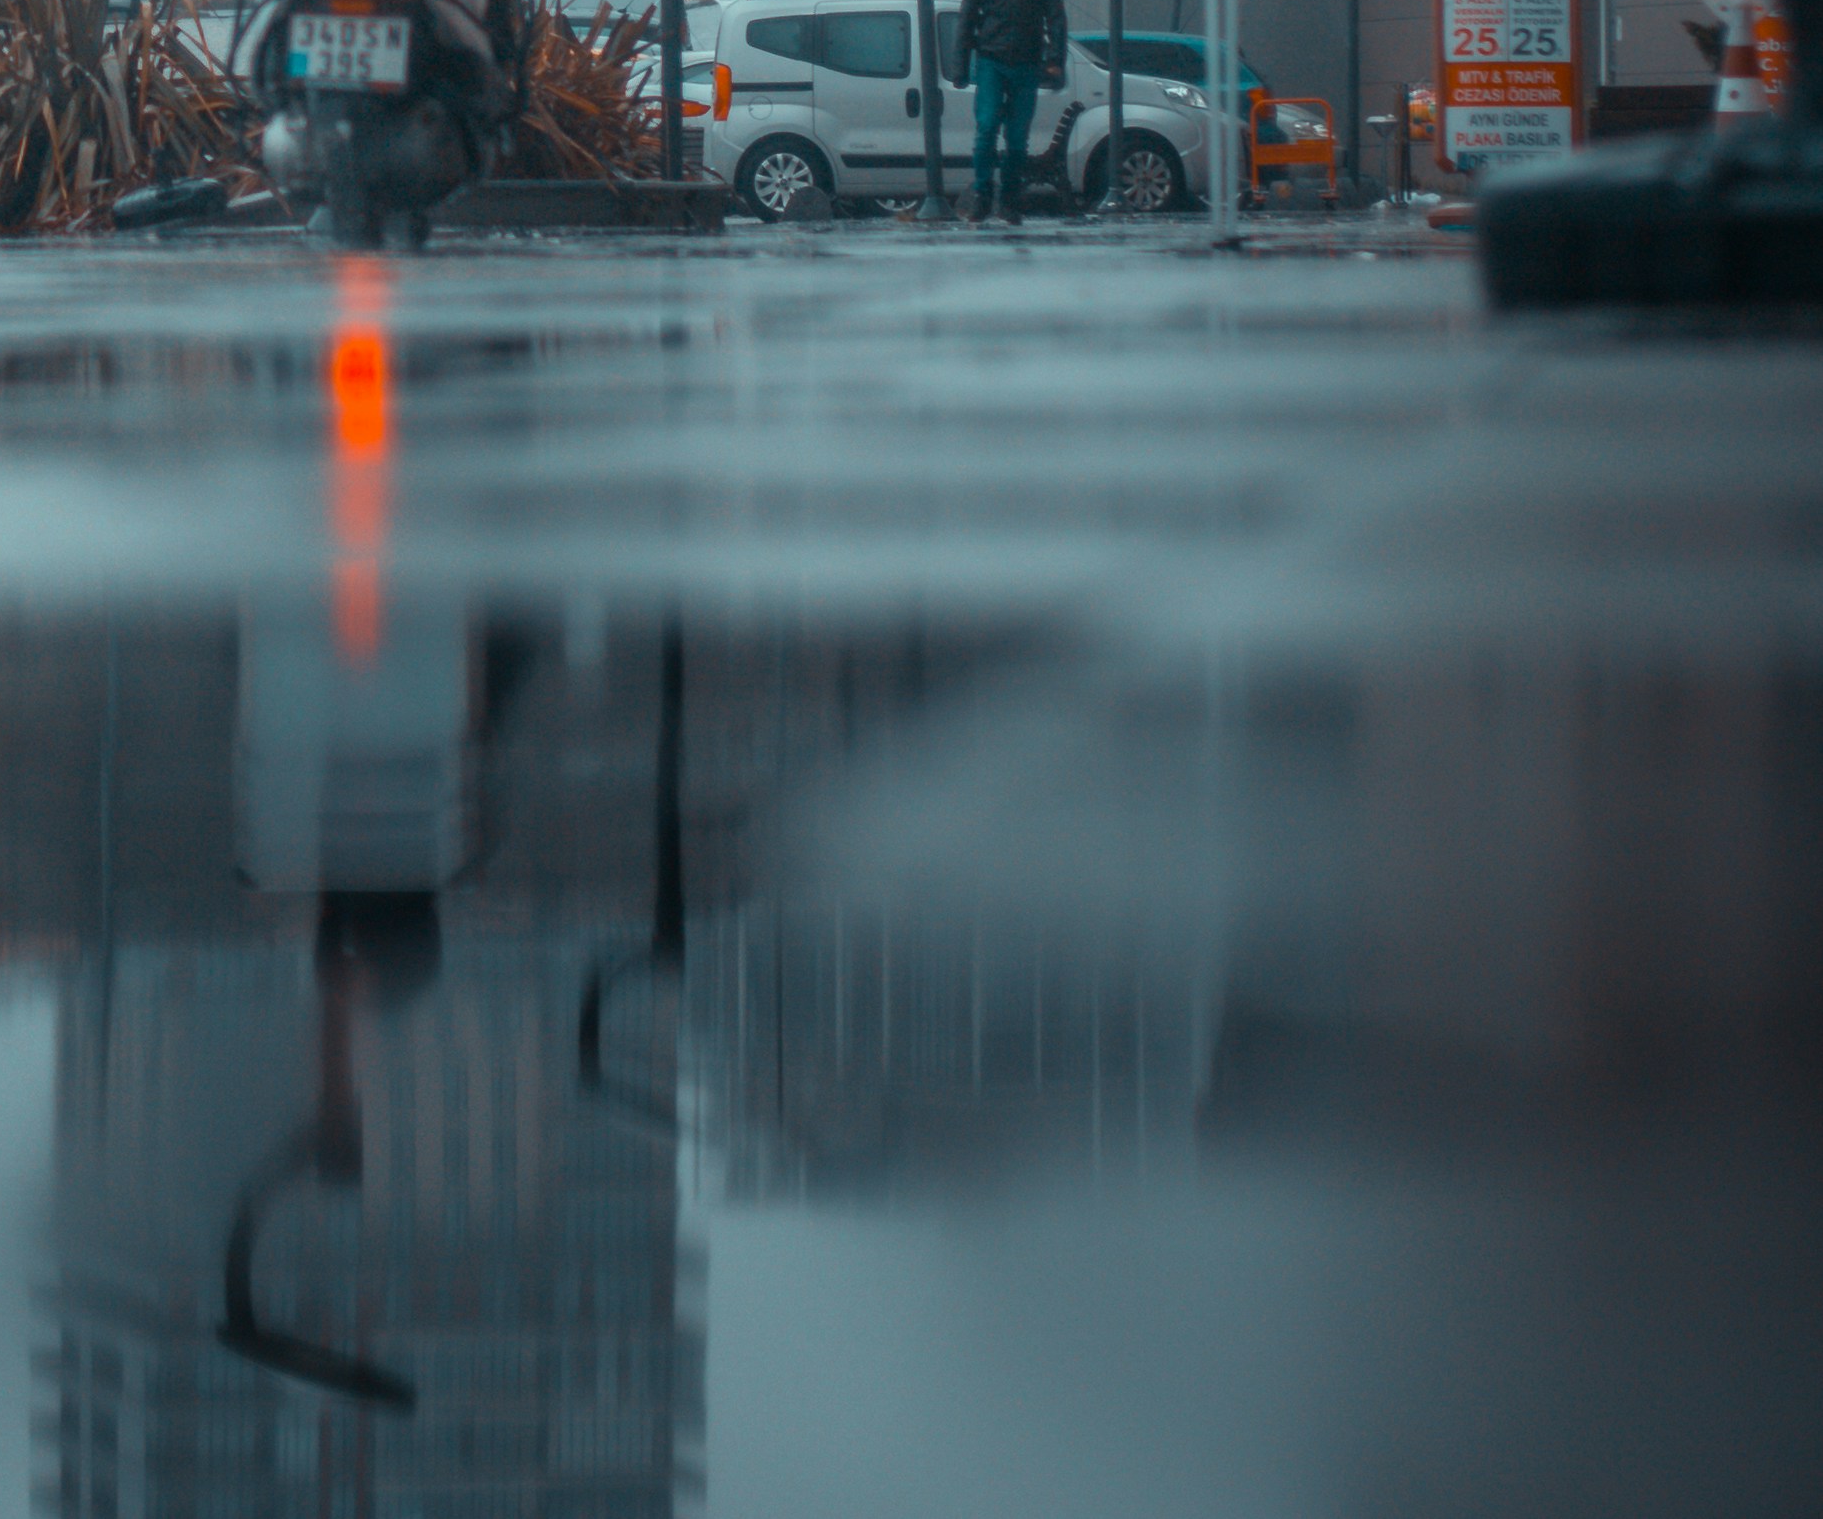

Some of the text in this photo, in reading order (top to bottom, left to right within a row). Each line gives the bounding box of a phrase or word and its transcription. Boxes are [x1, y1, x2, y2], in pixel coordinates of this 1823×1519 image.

[1453, 28, 1499, 56] 25
[1512, 27, 1558, 56] 25
[1459, 68, 1556, 84] MTV & TRAFİK
[1454, 86, 1562, 102] CEZASI ÖDENİR
[1469, 111, 1549, 127] AYNI GÜNDE
[1455, 132, 1561, 146] PLAKA BASILIR
